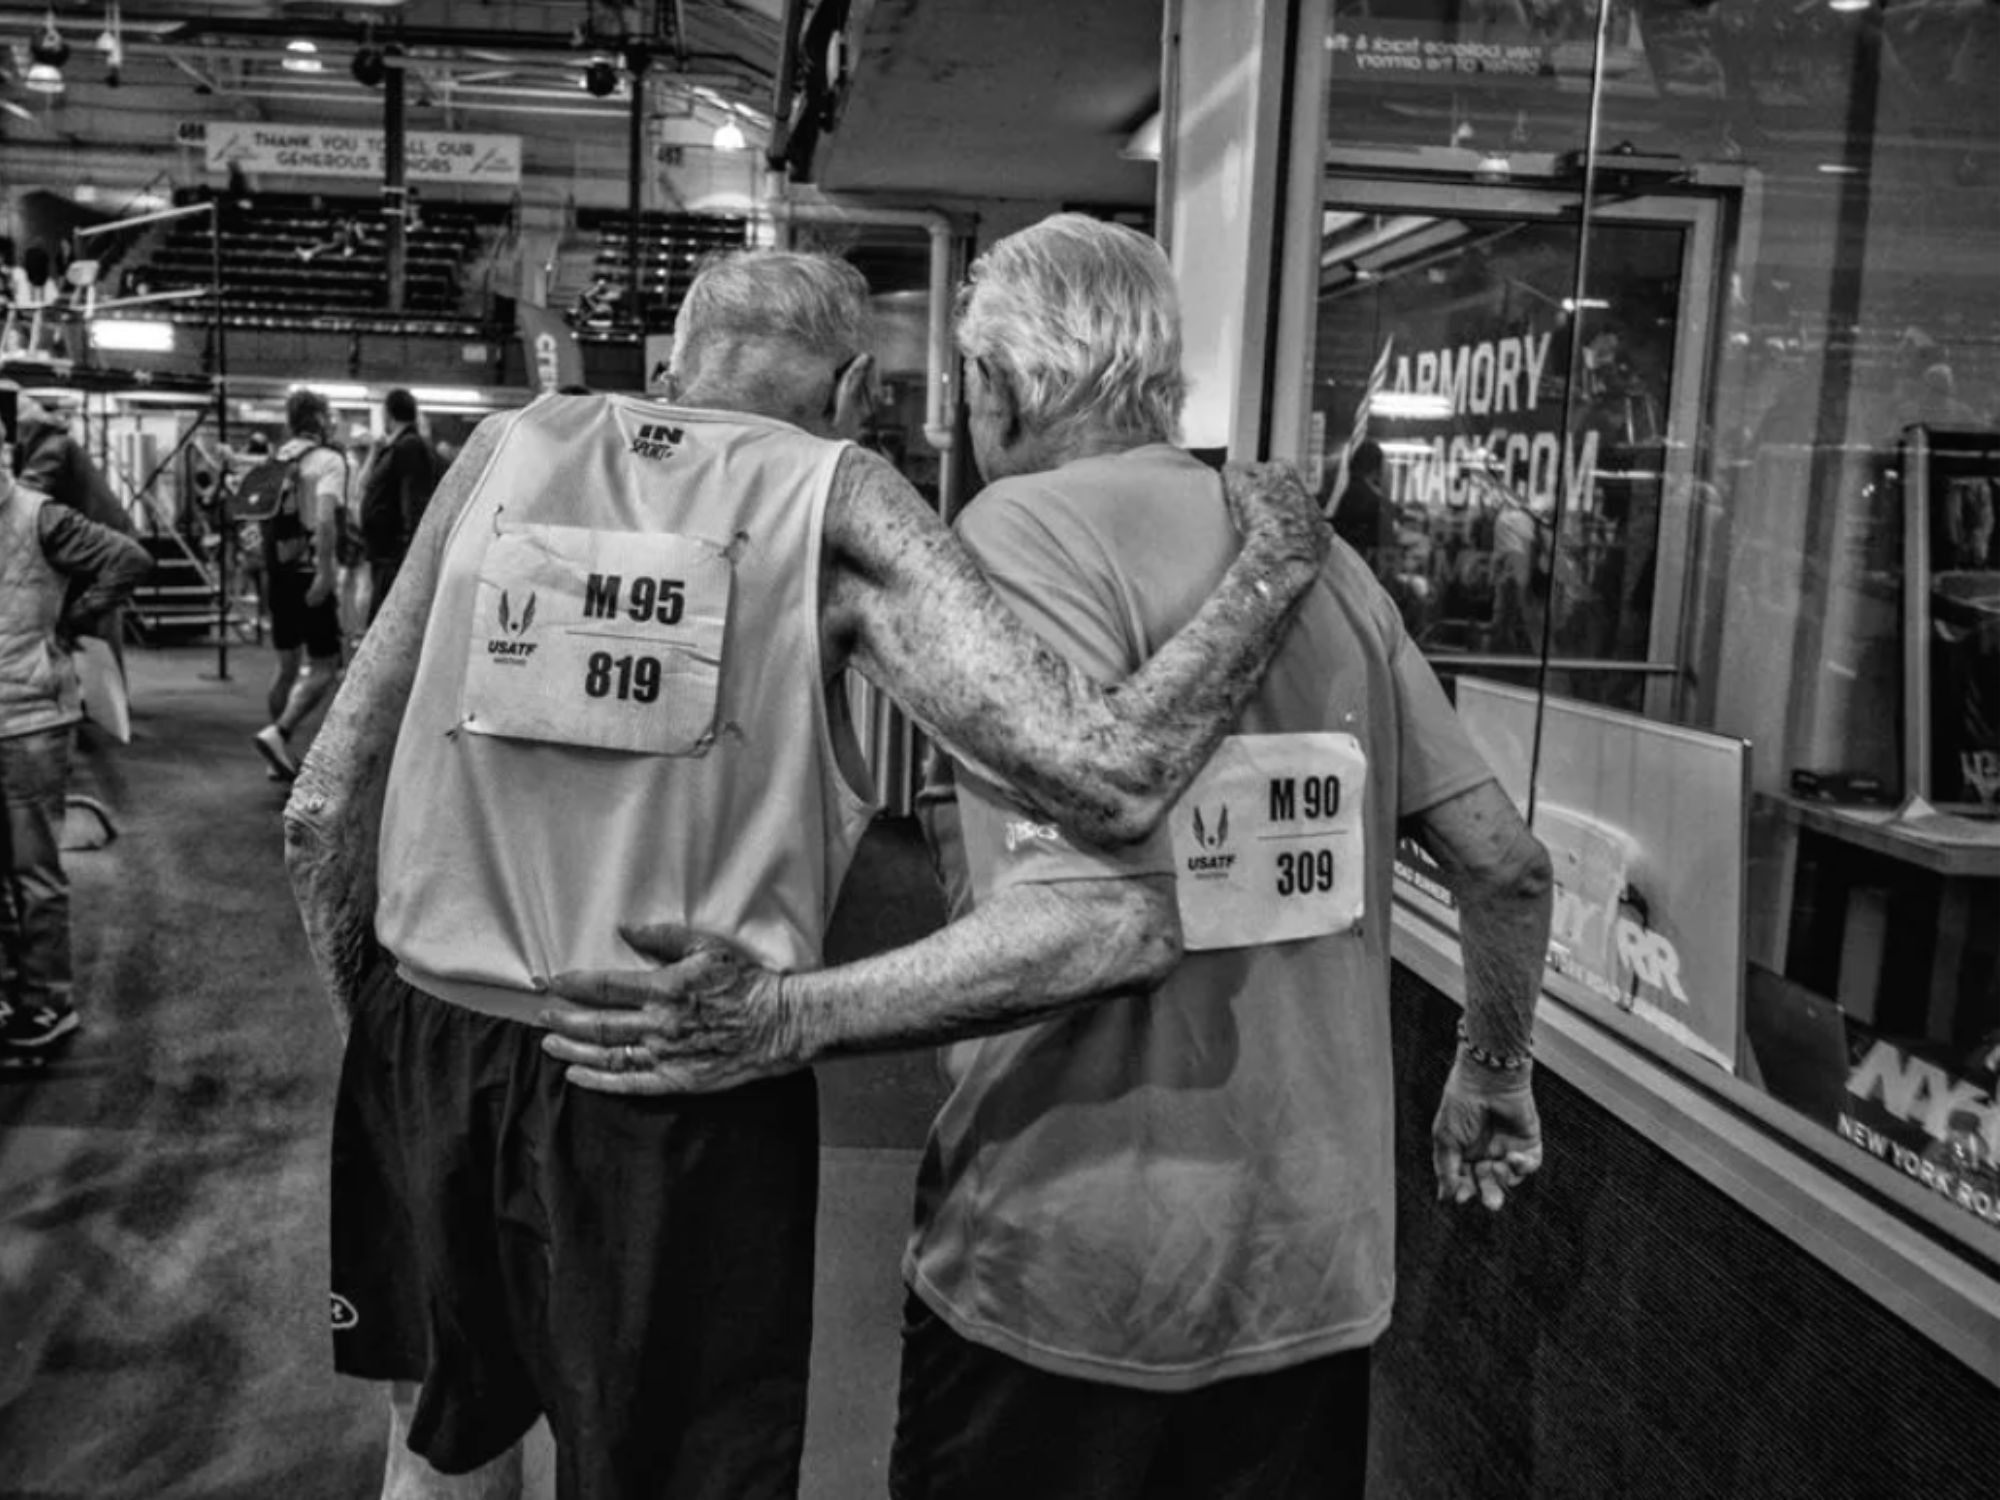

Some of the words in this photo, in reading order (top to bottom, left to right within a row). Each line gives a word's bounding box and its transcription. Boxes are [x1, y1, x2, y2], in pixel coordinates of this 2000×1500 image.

[255, 132, 311, 147] THANK
[320, 136, 358, 151] YOU
[436, 142, 475, 157] OUR
[276, 151, 371, 170] GENEROUS
[1394, 331, 1551, 416] ARMORY
[640, 424, 684, 444] IN
[583, 573, 622, 619] M
[627, 576, 686, 625] 95
[487, 640, 538, 657] USATF
[584, 651, 662, 704] 819
[1269, 777, 1296, 822] M
[1303, 774, 1341, 820] 90
[1187, 854, 1236, 871] USATF
[1276, 849, 1334, 896] 309
[1837, 1112, 1885, 1158] NEW
[1890, 1140, 1951, 1197] YORK
[1956, 1179, 2000, 1226] RO
